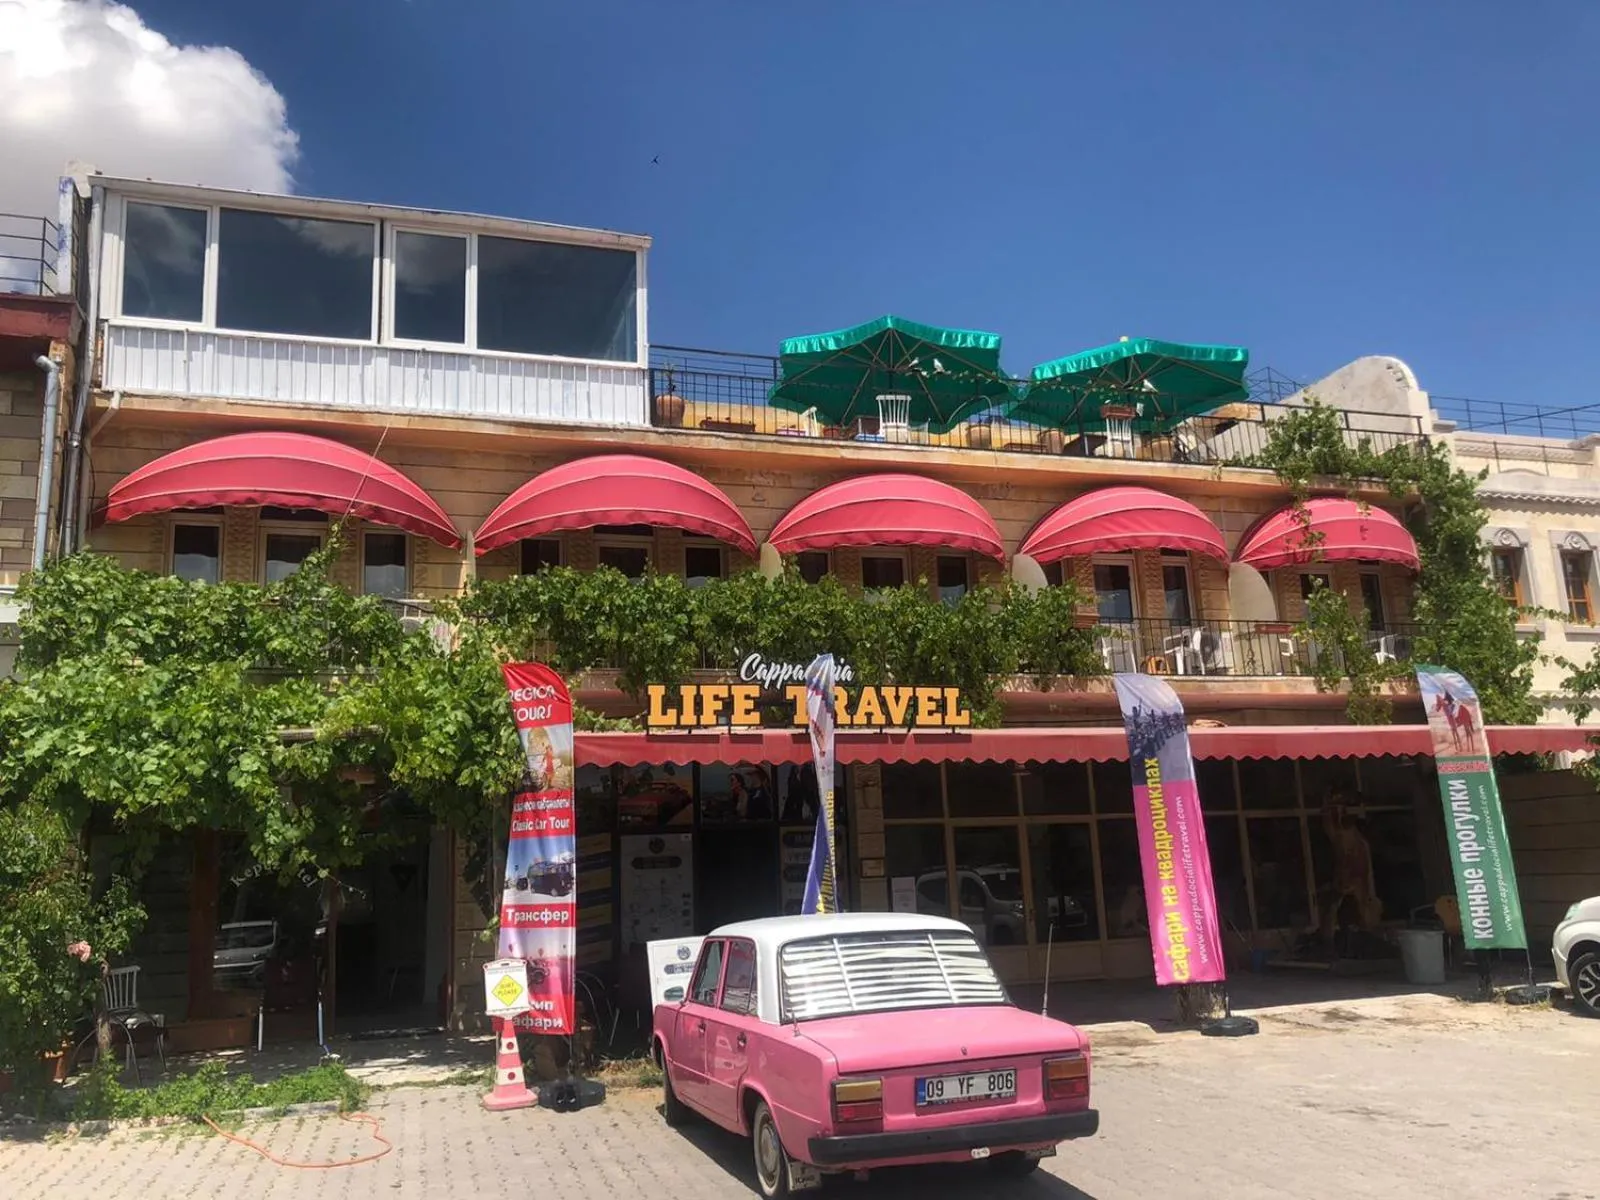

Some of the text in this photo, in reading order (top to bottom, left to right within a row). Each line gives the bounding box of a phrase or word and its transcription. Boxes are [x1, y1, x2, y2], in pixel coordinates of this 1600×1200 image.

[740, 653, 855, 690] Cappaia
[647, 684, 971, 726] LIFE TRAVEL
[549, 816, 570, 829] Tour
[1145, 757, 1190, 983] сафари на квадроциклах
[1448, 779, 1494, 939] конные прогулки
[505, 908, 569, 925] Трансфер
[513, 1015, 564, 1030] афари
[927, 1080, 944, 1098] 09
[958, 1077, 975, 1095] YF
[988, 1072, 1013, 1091] 806
